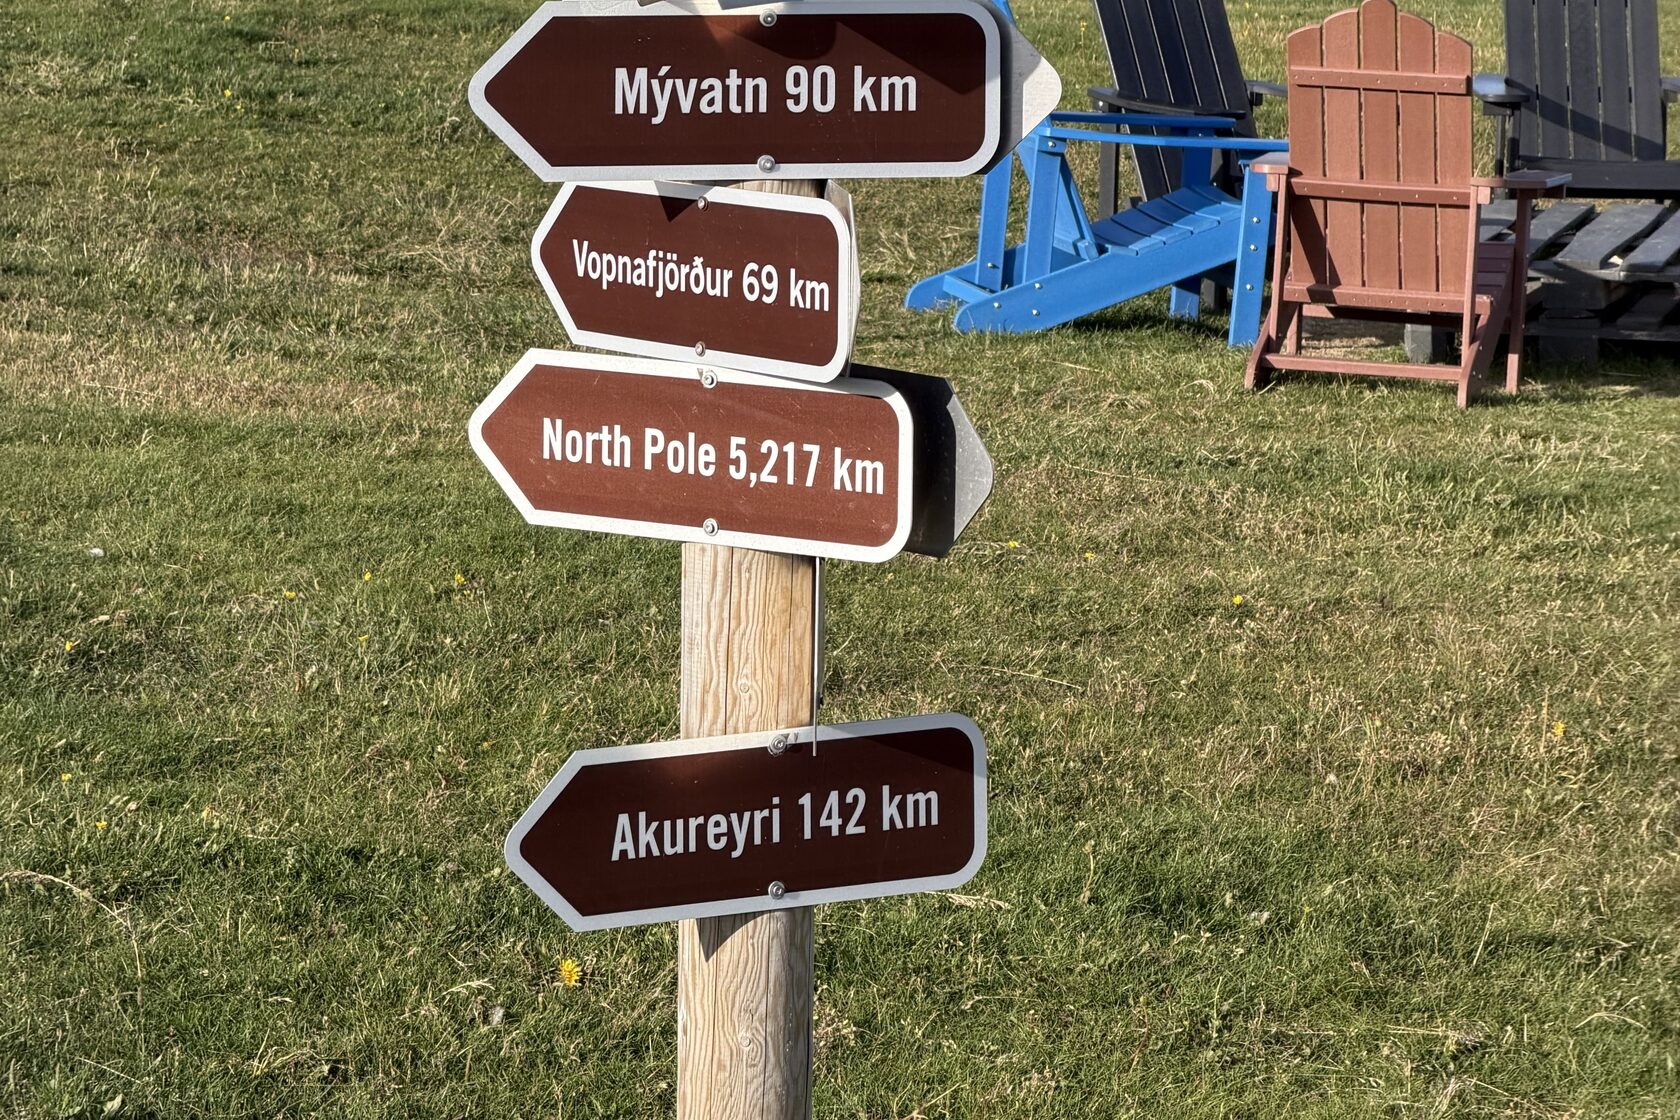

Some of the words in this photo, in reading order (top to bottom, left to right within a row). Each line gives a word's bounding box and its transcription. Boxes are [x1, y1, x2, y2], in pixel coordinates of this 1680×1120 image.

[614, 65, 768, 125] Mývatn
[785, 64, 836, 113] 90
[853, 65, 917, 112] km
[572, 238, 733, 298] Vopnafjörður
[742, 262, 779, 304] 69
[789, 267, 830, 312] km
[542, 417, 631, 468] North
[644, 427, 716, 477] Pole
[729, 436, 821, 488] 5,217
[833, 446, 884, 495] km
[610, 796, 780, 862] Akureyri
[798, 787, 866, 840] 142
[882, 784, 939, 831] km
